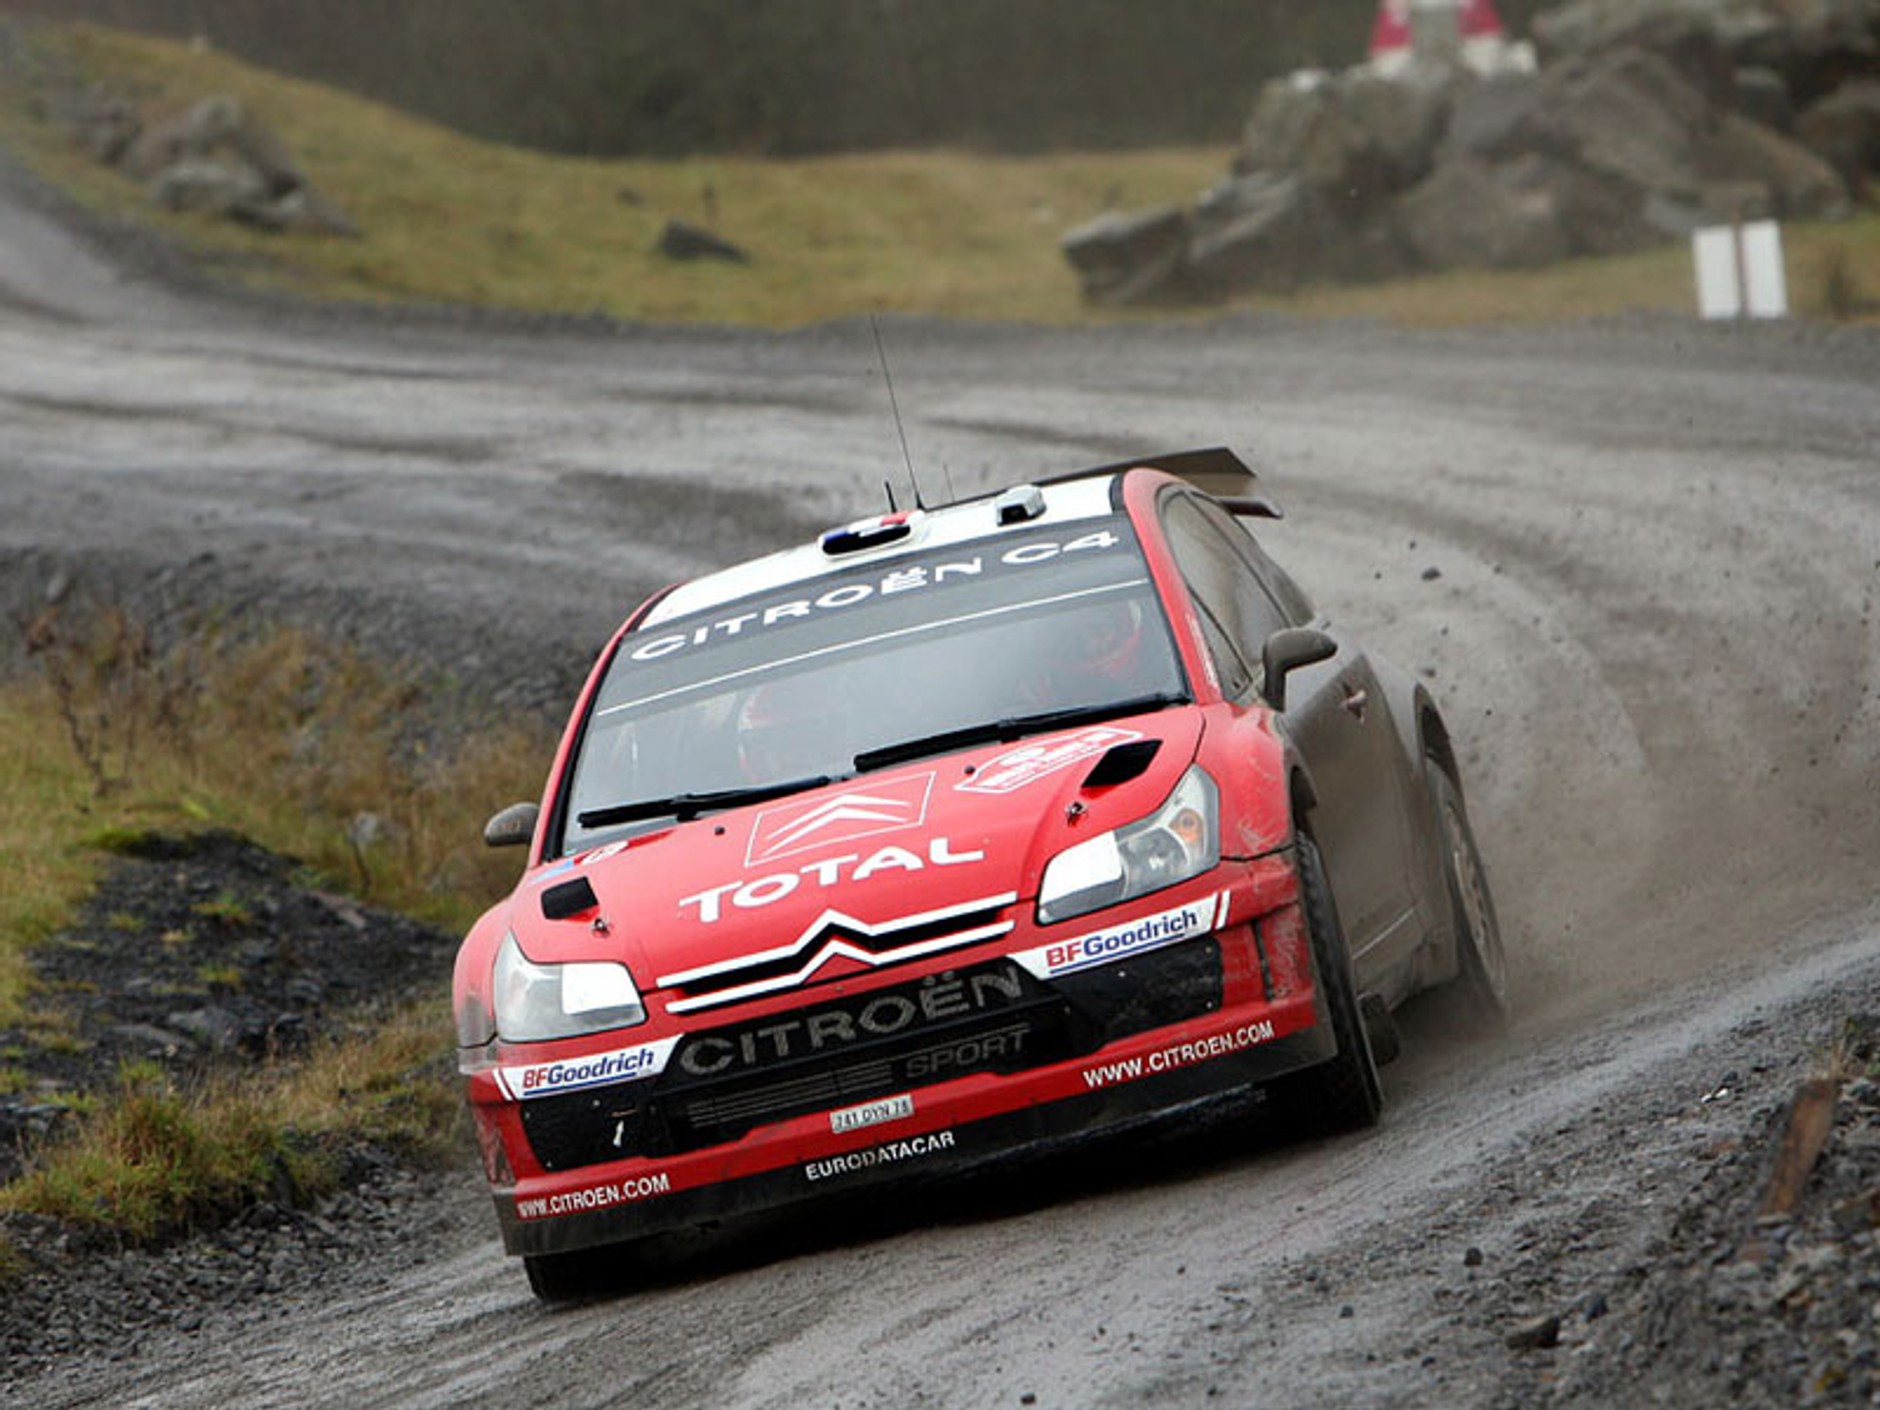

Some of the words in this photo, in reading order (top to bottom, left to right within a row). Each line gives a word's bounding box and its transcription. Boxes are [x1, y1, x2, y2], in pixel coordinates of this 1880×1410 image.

[632, 556, 983, 660] CITROËN
[1001, 530, 1119, 564] C4
[679, 837, 985, 923] TOTAL
[1046, 910, 1198, 967] BFGoodrich
[680, 964, 1023, 1074] CITROËN
[522, 1048, 655, 1090] BFGoodrich
[905, 1028, 1030, 1078] SPORT
[1083, 1019, 1275, 1088] WWW.CITROEN.COM
[805, 1130, 956, 1180] EURODATACAR
[517, 1172, 671, 1219] WWW.CITROEN.COM
